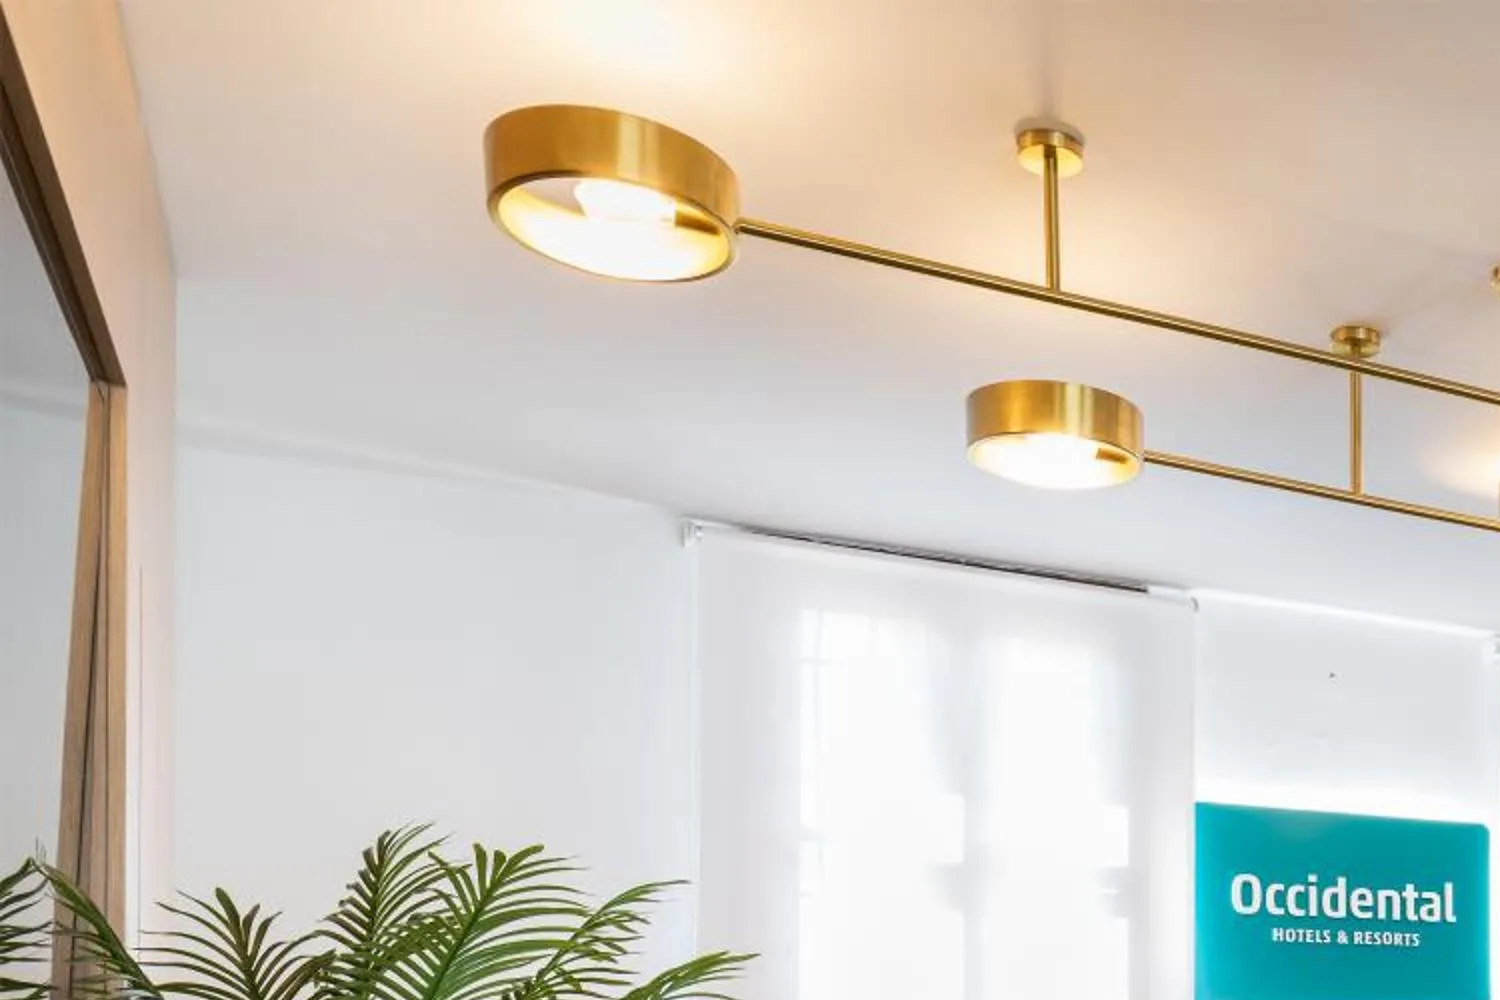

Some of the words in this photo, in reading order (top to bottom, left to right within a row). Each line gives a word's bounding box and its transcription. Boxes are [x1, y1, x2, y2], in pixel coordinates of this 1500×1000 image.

[1230, 872, 1457, 923] Occidental
[1271, 927, 1332, 944] HOTELS
[1336, 929, 1349, 945] &
[1353, 931, 1421, 947] RESORTS
